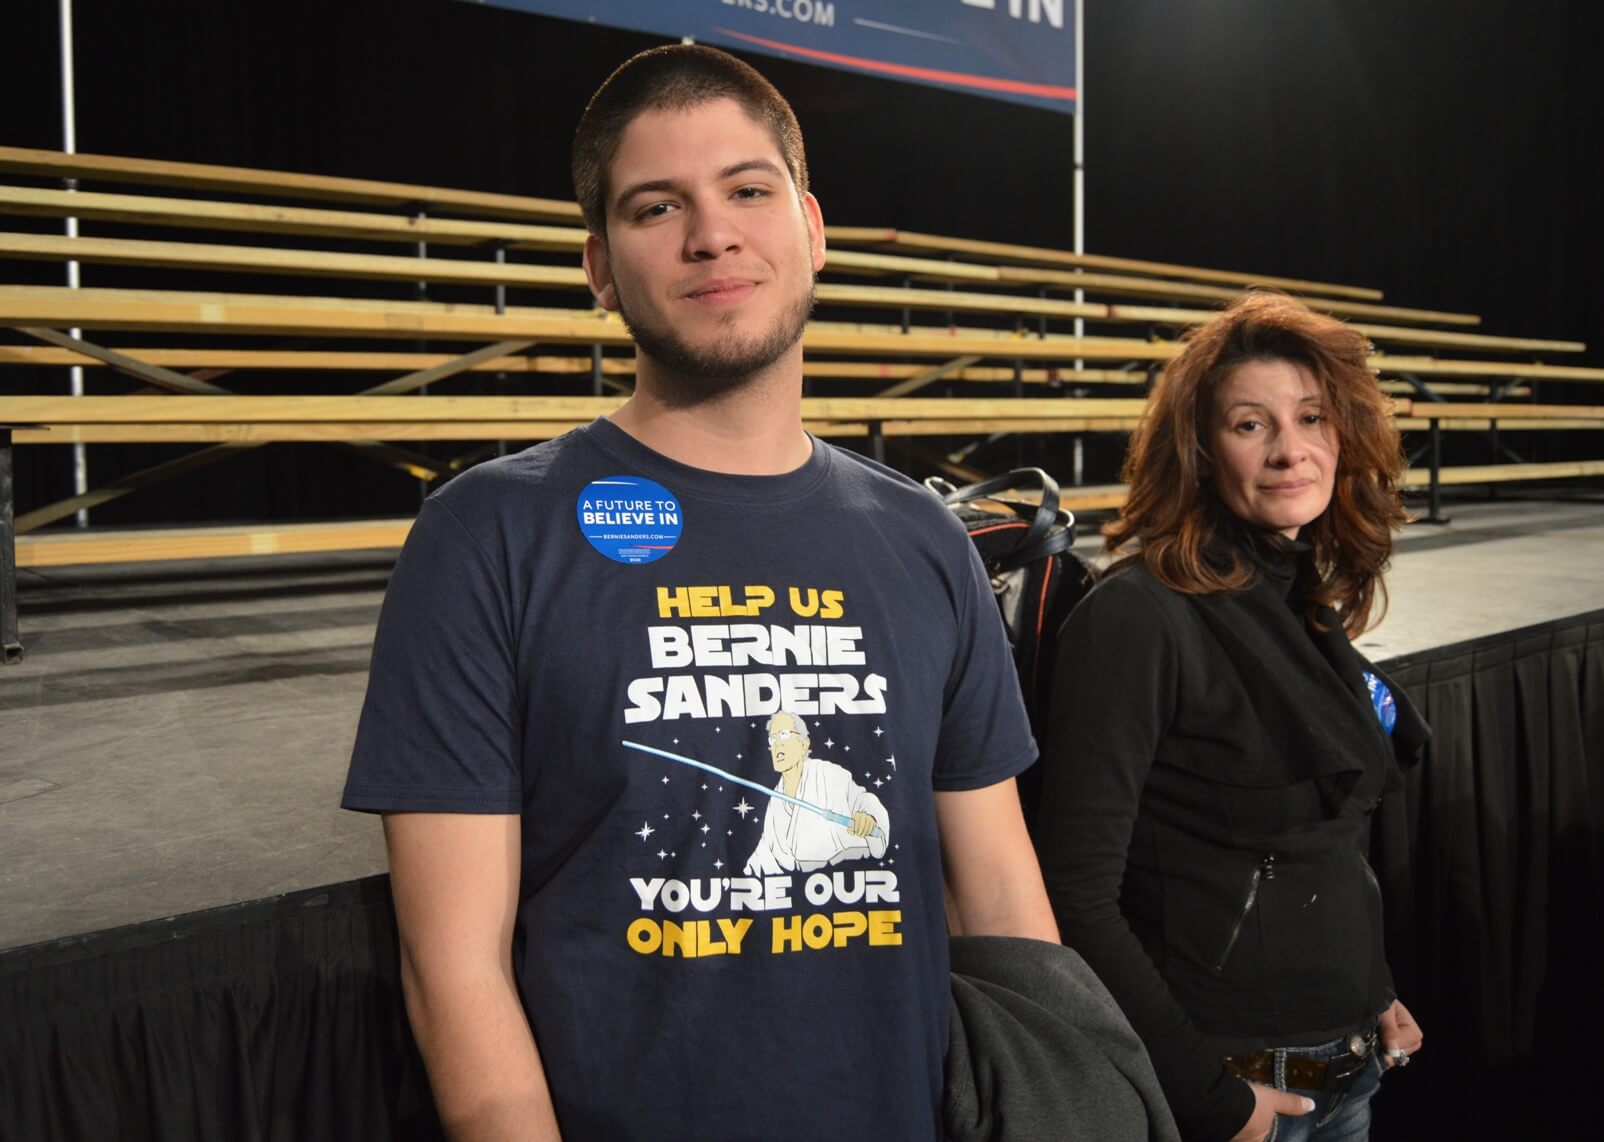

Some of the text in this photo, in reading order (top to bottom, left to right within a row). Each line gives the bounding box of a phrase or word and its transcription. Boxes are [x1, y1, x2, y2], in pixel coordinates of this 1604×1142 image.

[719, 0, 835, 27] S.COM
[583, 500, 676, 511] A FUTURE TO
[583, 512, 679, 525] BELIEVE IN
[656, 585, 845, 619] HELP US
[647, 624, 866, 669] BERNIE
[624, 673, 887, 724] SANDERS
[629, 870, 900, 913] YOU'RE OUR
[626, 910, 903, 958] ONLY HOPE
